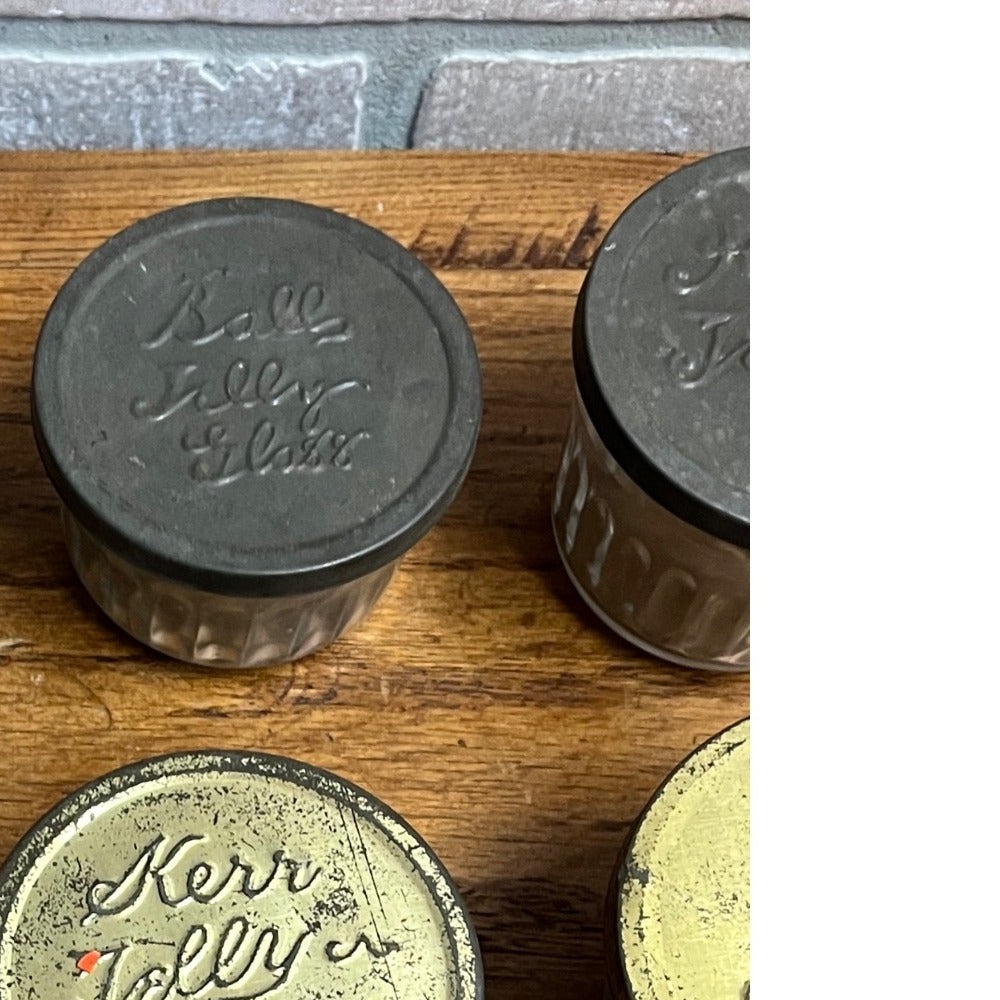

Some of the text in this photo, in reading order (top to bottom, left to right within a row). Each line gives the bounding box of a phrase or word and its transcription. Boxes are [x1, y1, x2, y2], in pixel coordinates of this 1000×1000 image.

[141, 267, 353, 348] Ball
[131, 358, 371, 438] Jelly
[180, 420, 371, 488] Glass
[82, 834, 322, 925] Kerr
